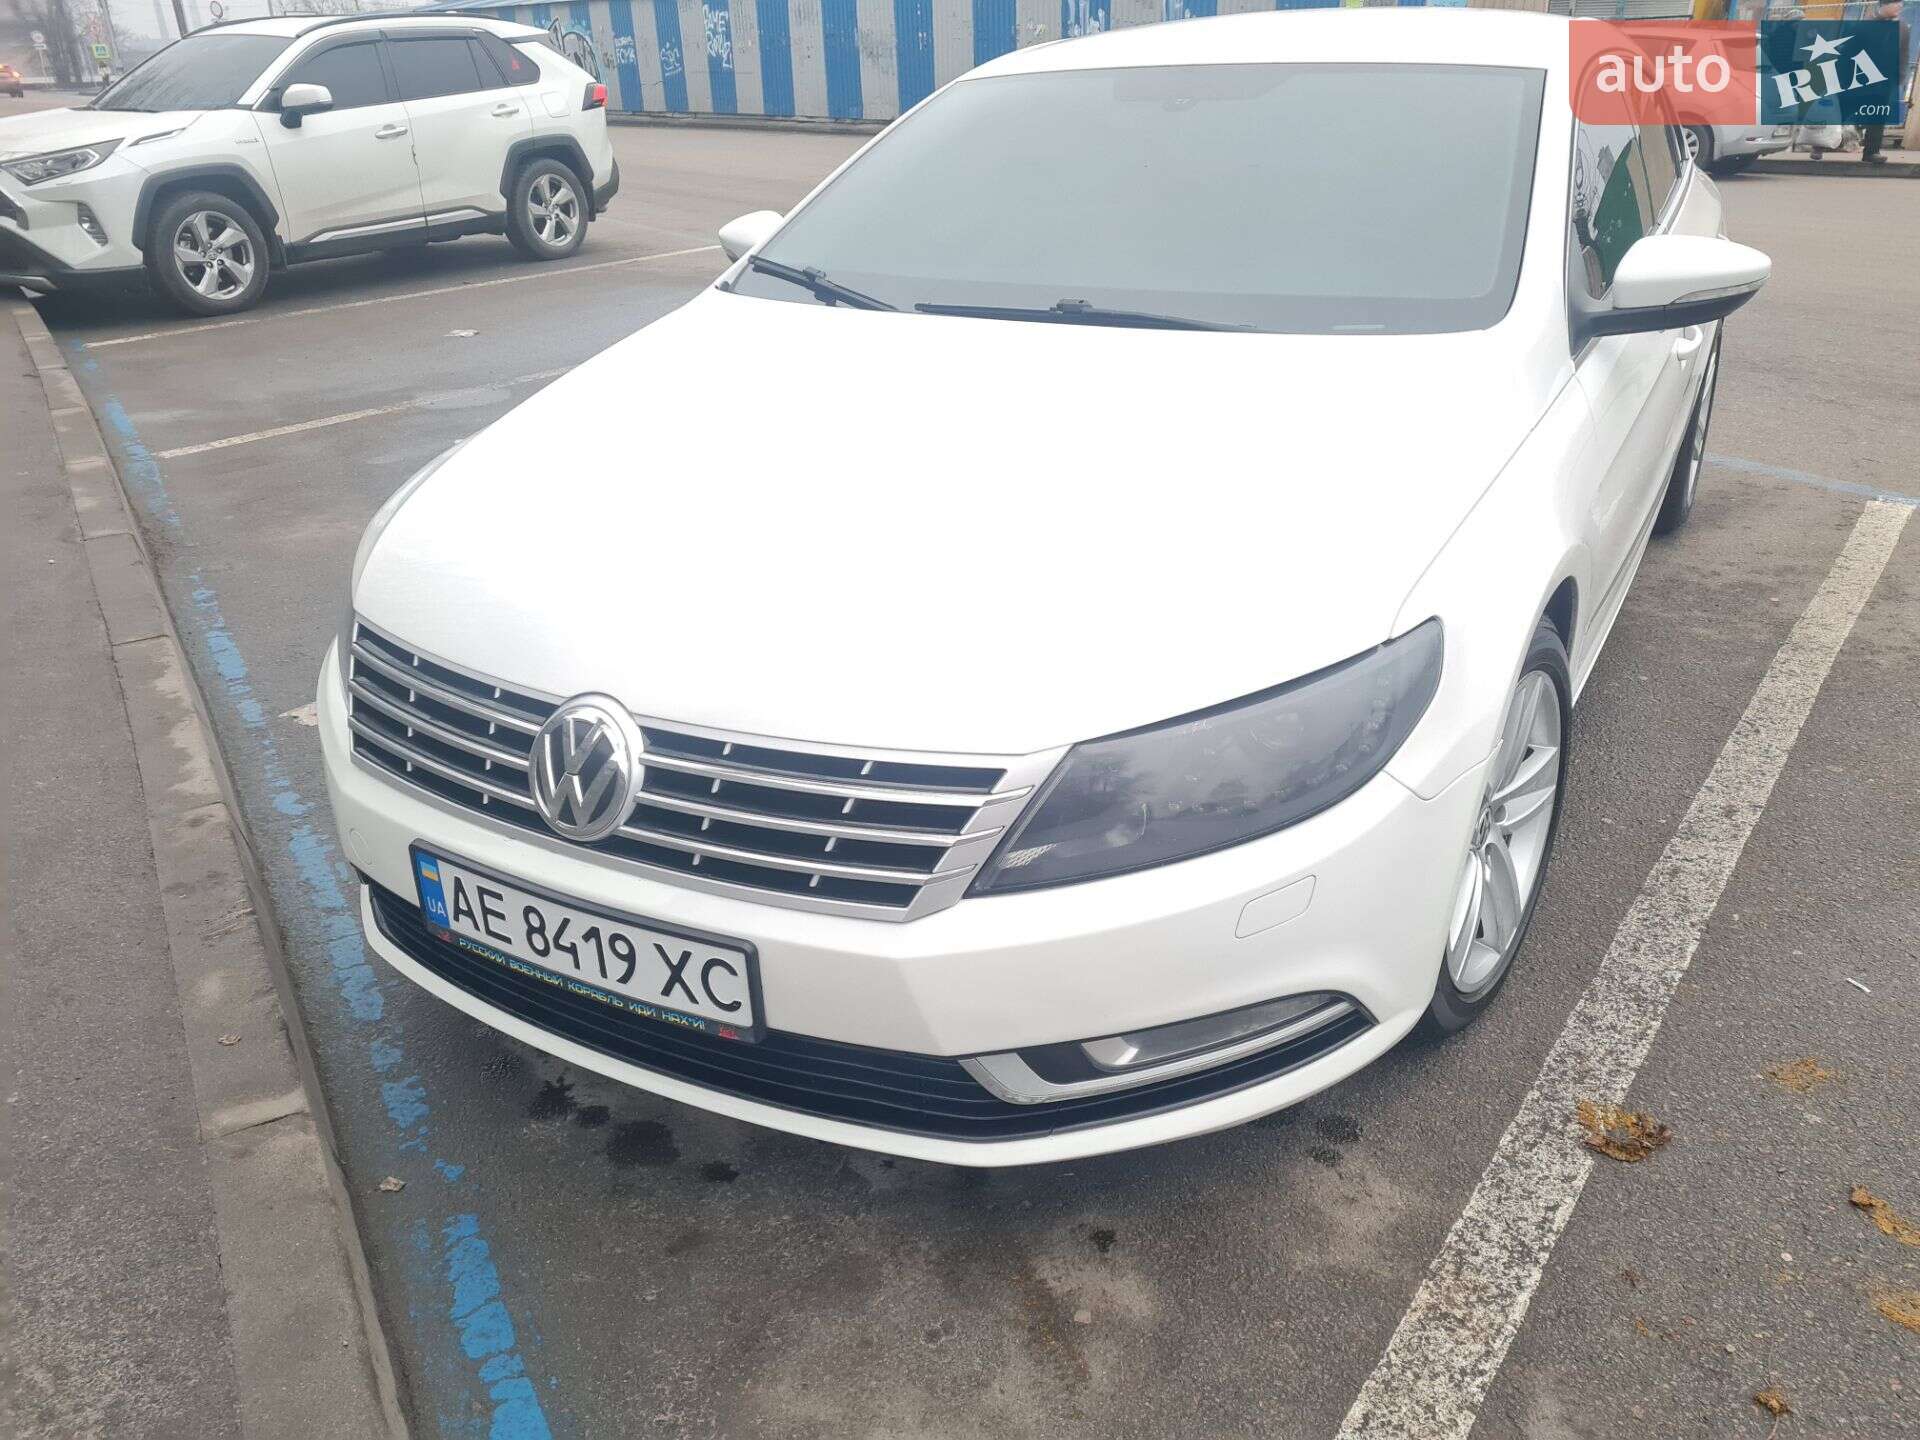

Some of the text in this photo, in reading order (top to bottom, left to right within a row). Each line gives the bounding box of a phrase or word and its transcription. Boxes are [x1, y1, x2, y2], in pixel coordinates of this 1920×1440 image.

[427, 896, 447, 918] UA
[453, 875, 742, 1012] AE 8419 XC
[568, 981, 624, 1008] КОРАБЛЬ
[628, 1003, 656, 1018] ИДИ
